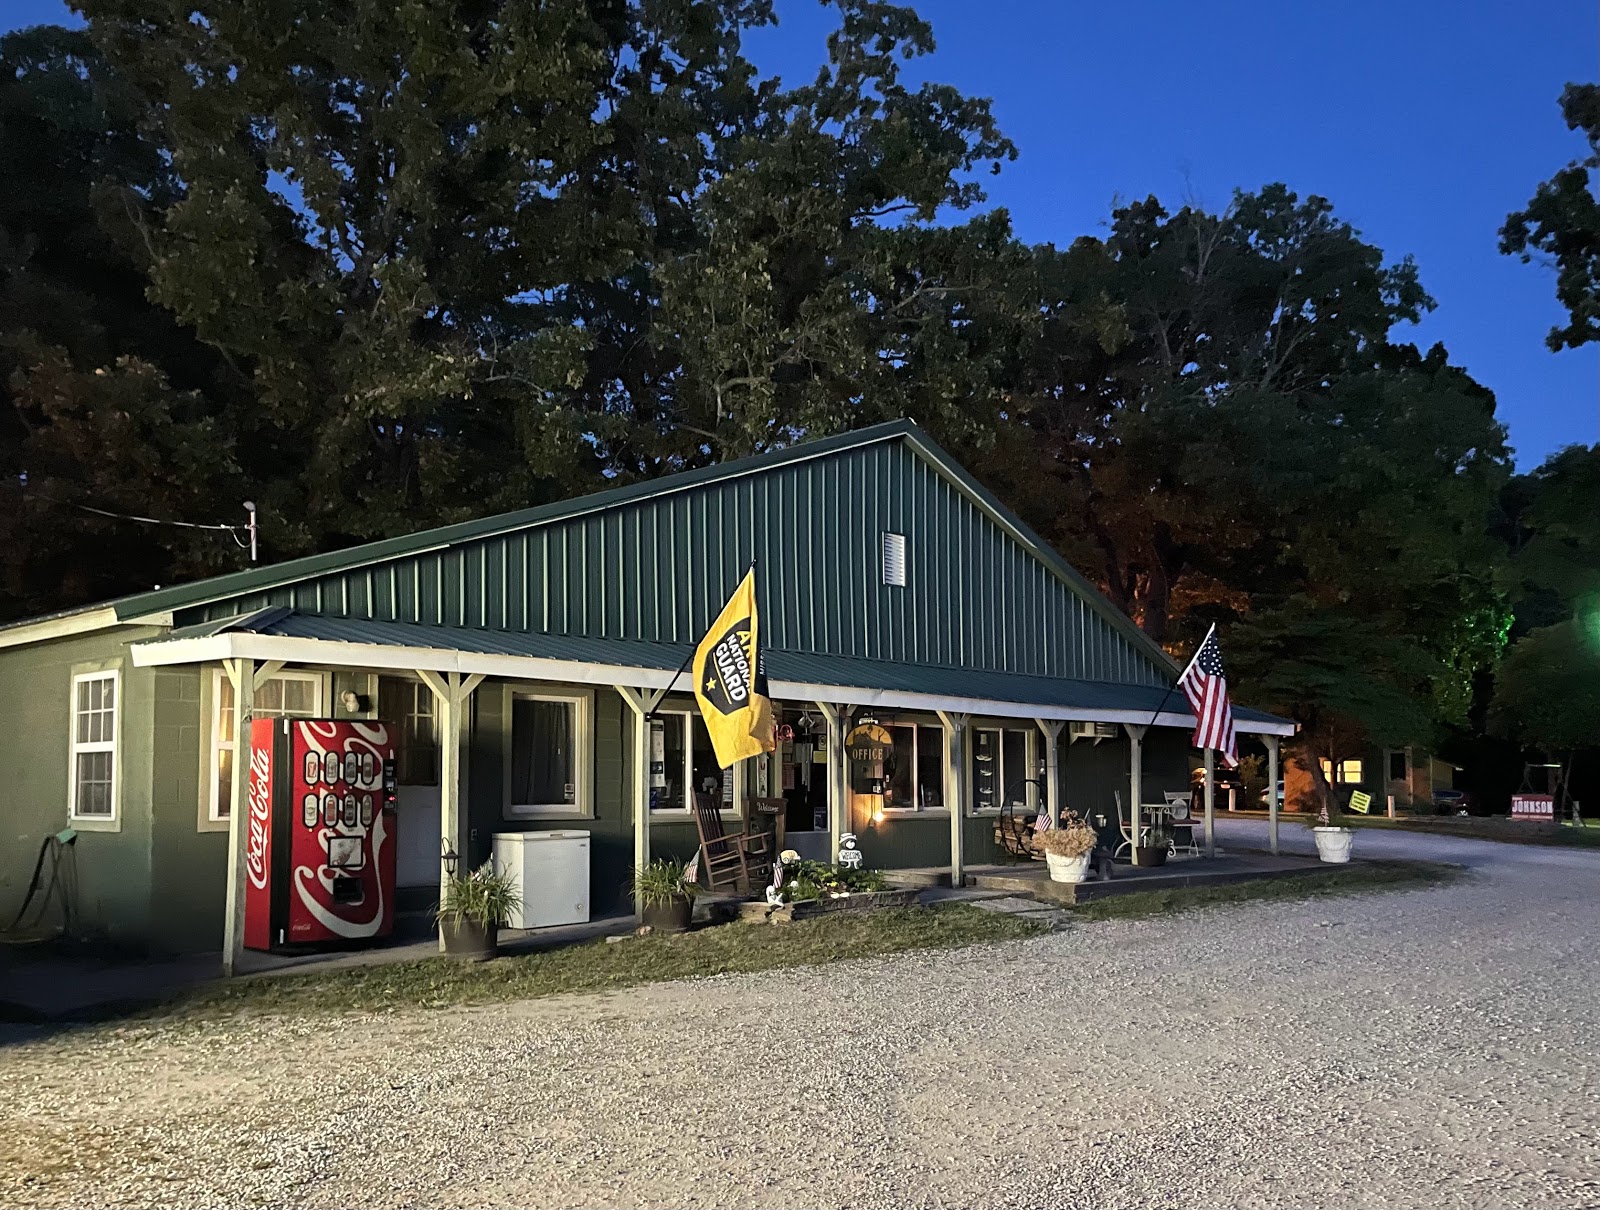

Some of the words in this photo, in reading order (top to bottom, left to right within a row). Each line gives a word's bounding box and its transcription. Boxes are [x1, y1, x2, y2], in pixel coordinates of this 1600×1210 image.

[716, 642, 747, 701] GUARD
[852, 748, 883, 760] OFFICE
[1511, 800, 1553, 813] JOHNSON
[246, 746, 270, 890] Coca-Cola
[841, 851, 861, 860] WELCOME
